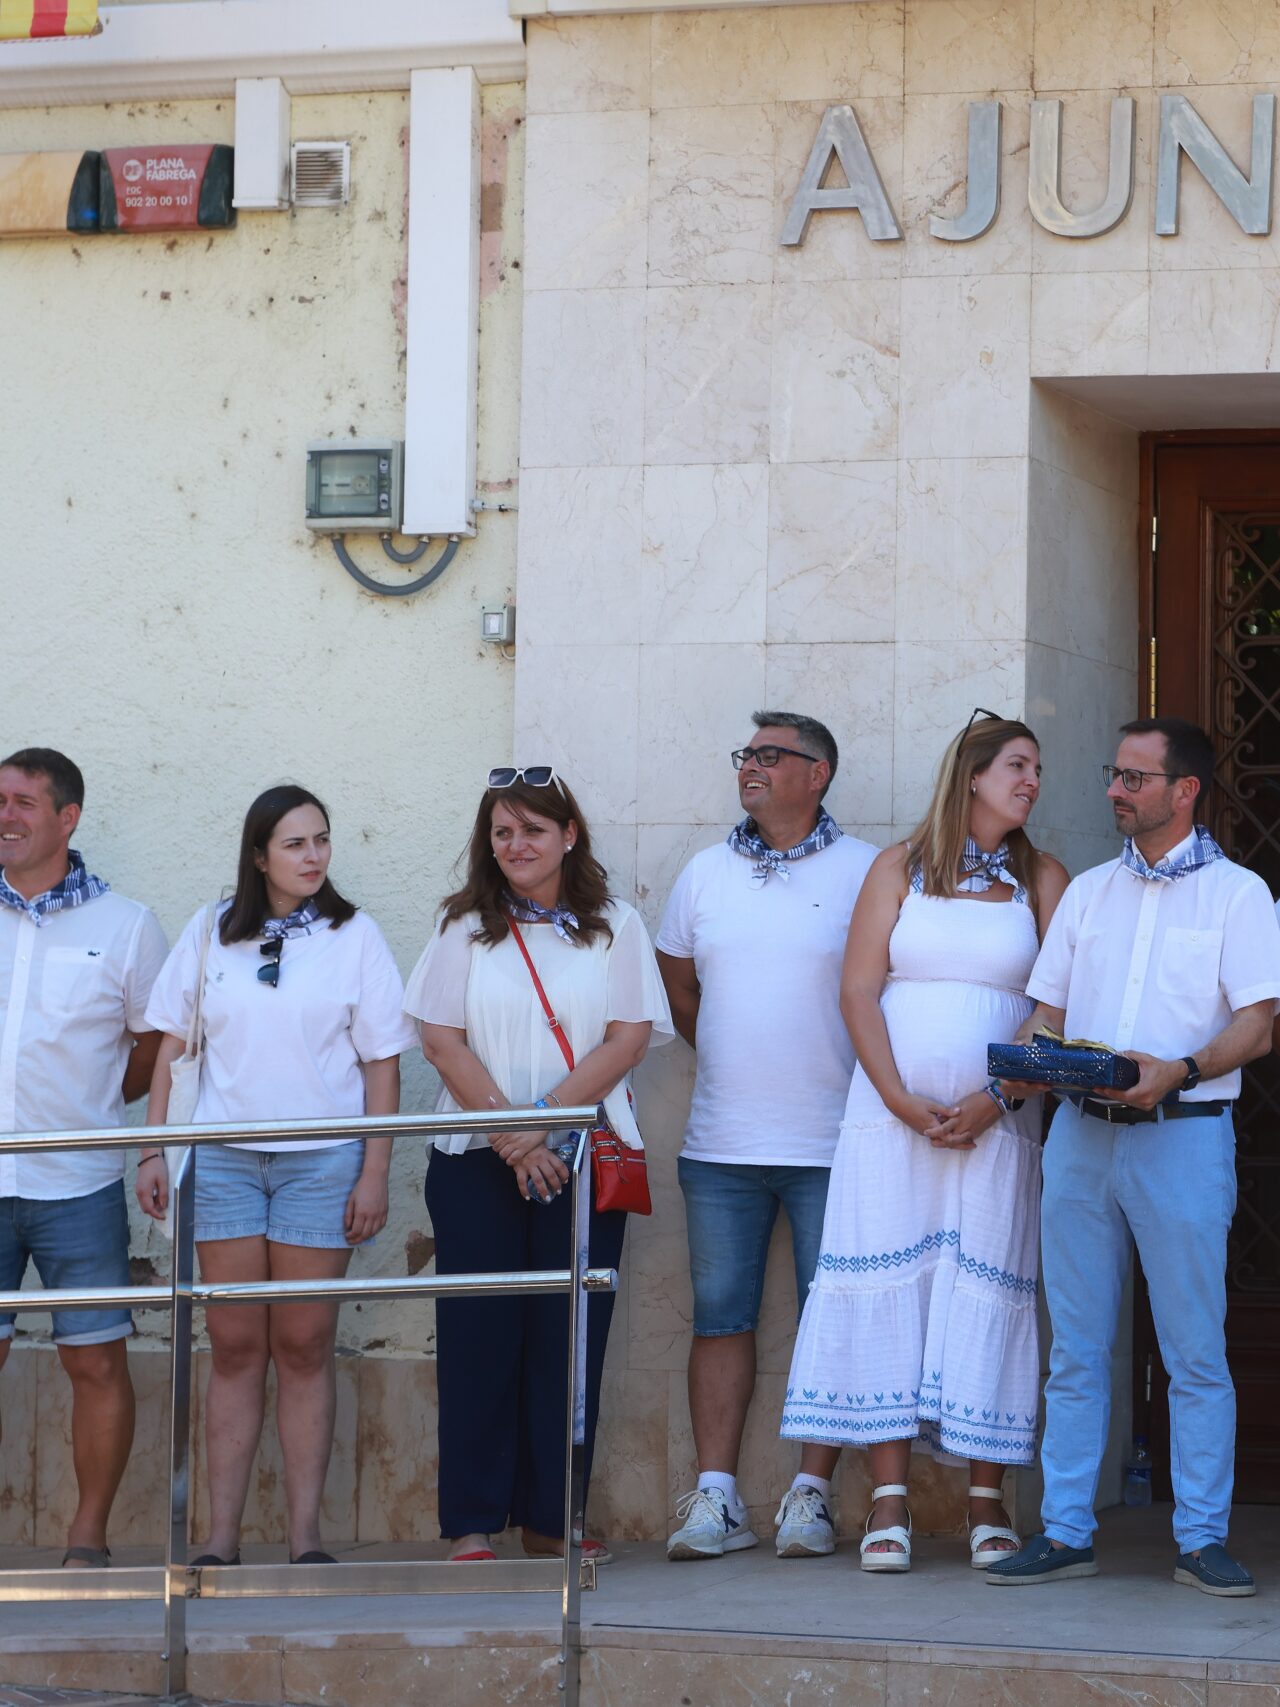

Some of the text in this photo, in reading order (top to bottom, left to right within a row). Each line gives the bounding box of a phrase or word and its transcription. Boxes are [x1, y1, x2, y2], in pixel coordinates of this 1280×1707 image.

[146, 158, 184, 170] PLANA
[125, 196, 143, 208] 902
[145, 196, 158, 207] 20
[159, 195, 173, 207] 00
[175, 194, 188, 206] 10
